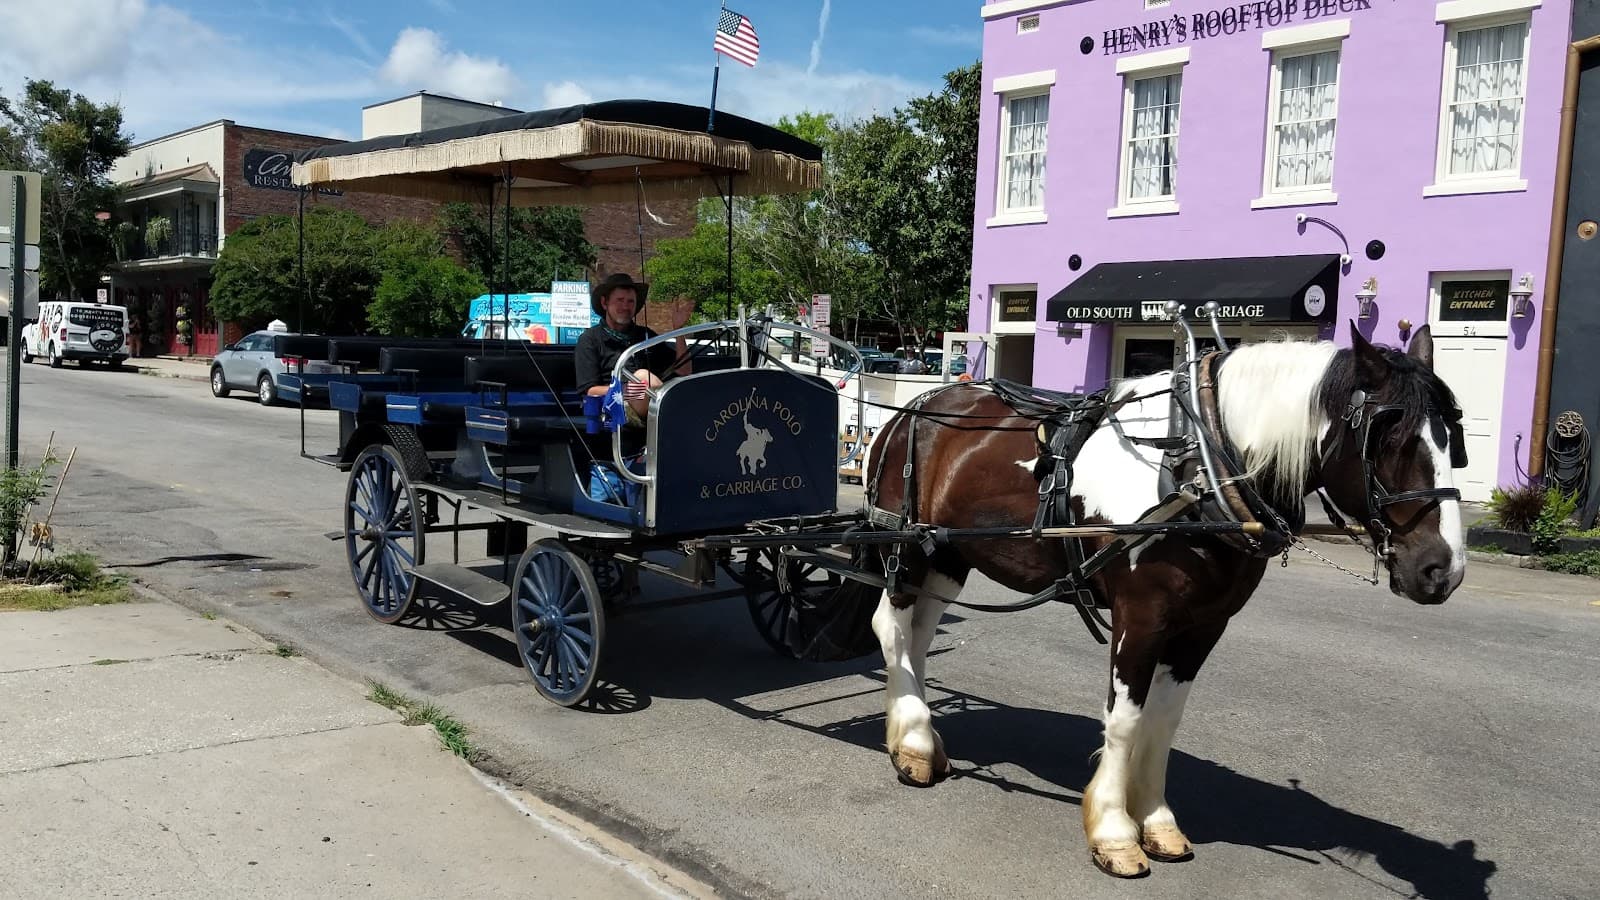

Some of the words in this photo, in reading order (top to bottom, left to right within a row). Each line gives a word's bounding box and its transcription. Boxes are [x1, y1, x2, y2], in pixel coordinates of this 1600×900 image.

[1102, 15, 1186, 52] HENRY'S
[1191, 0, 1298, 36] ROOFTOP
[554, 282, 588, 293] PARKING
[1452, 290, 1494, 299] KITCHEN
[1449, 299, 1496, 309] ENTRANCE
[1066, 307, 1091, 319] OLD
[1093, 306, 1133, 319] SOUTH
[1194, 304, 1265, 318] CRIAGE
[1463, 326, 1477, 336] 54
[705, 396, 768, 442] CAROLINA
[773, 401, 802, 436] POLO
[700, 486, 710, 498] &
[715, 478, 777, 497] CARRIAGE
[783, 475, 806, 490] CO.
